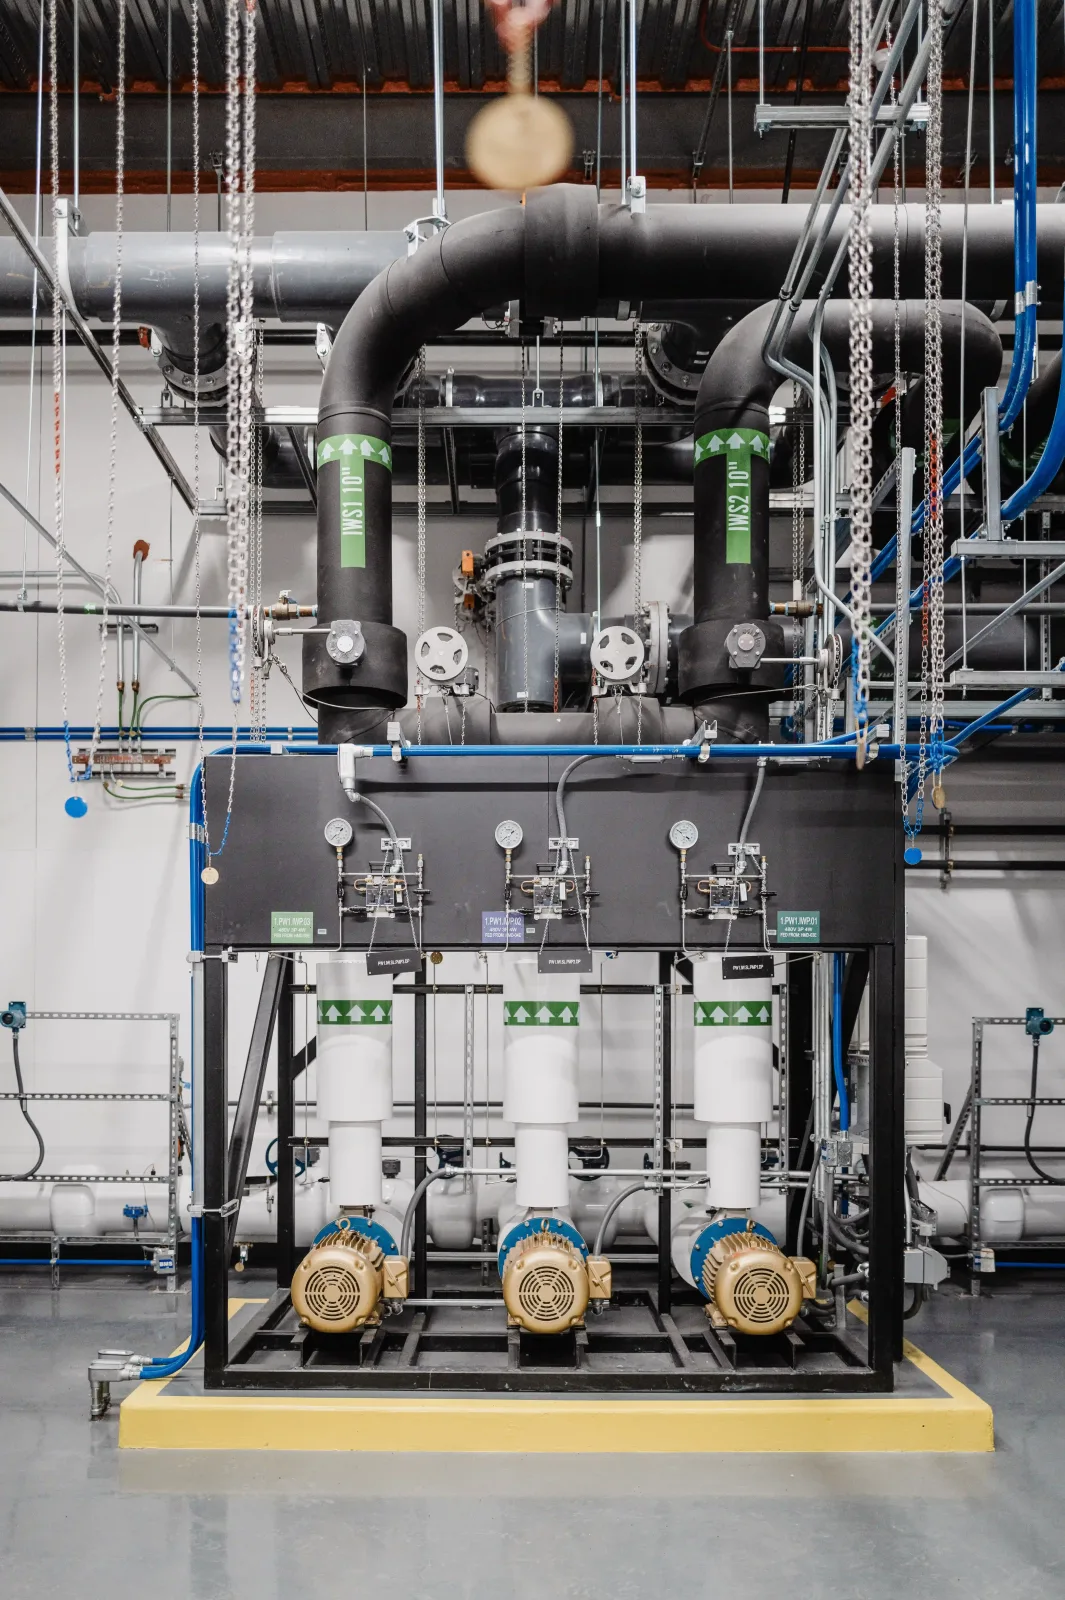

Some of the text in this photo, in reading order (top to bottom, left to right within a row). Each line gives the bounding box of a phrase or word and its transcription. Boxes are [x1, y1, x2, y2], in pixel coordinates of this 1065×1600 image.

[341, 466, 363, 535] IWS1 10"
[728, 461, 749, 531] IWS2 10"
